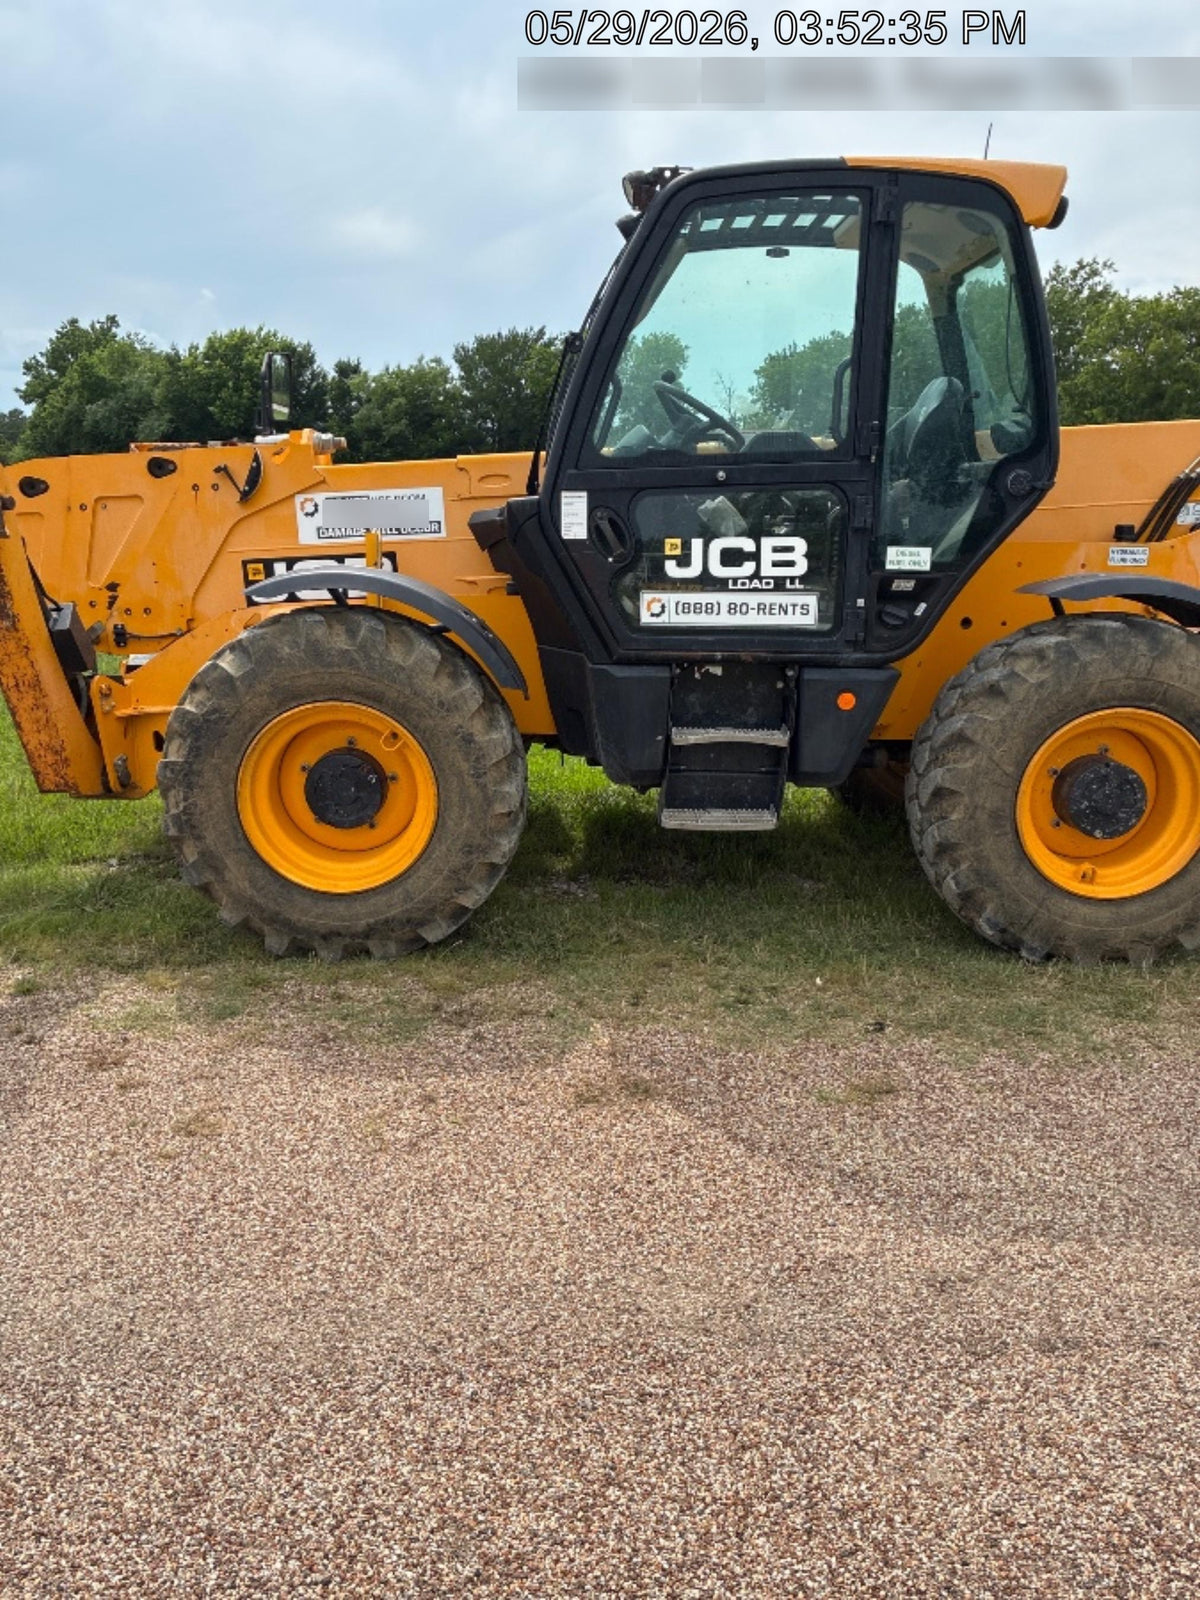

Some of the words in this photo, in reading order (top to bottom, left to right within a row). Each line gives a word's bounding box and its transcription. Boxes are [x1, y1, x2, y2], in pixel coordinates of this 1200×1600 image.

[664, 536, 808, 578] JCB
[674, 600, 721, 616] (888)
[726, 601, 811, 616] 80-RENTS
